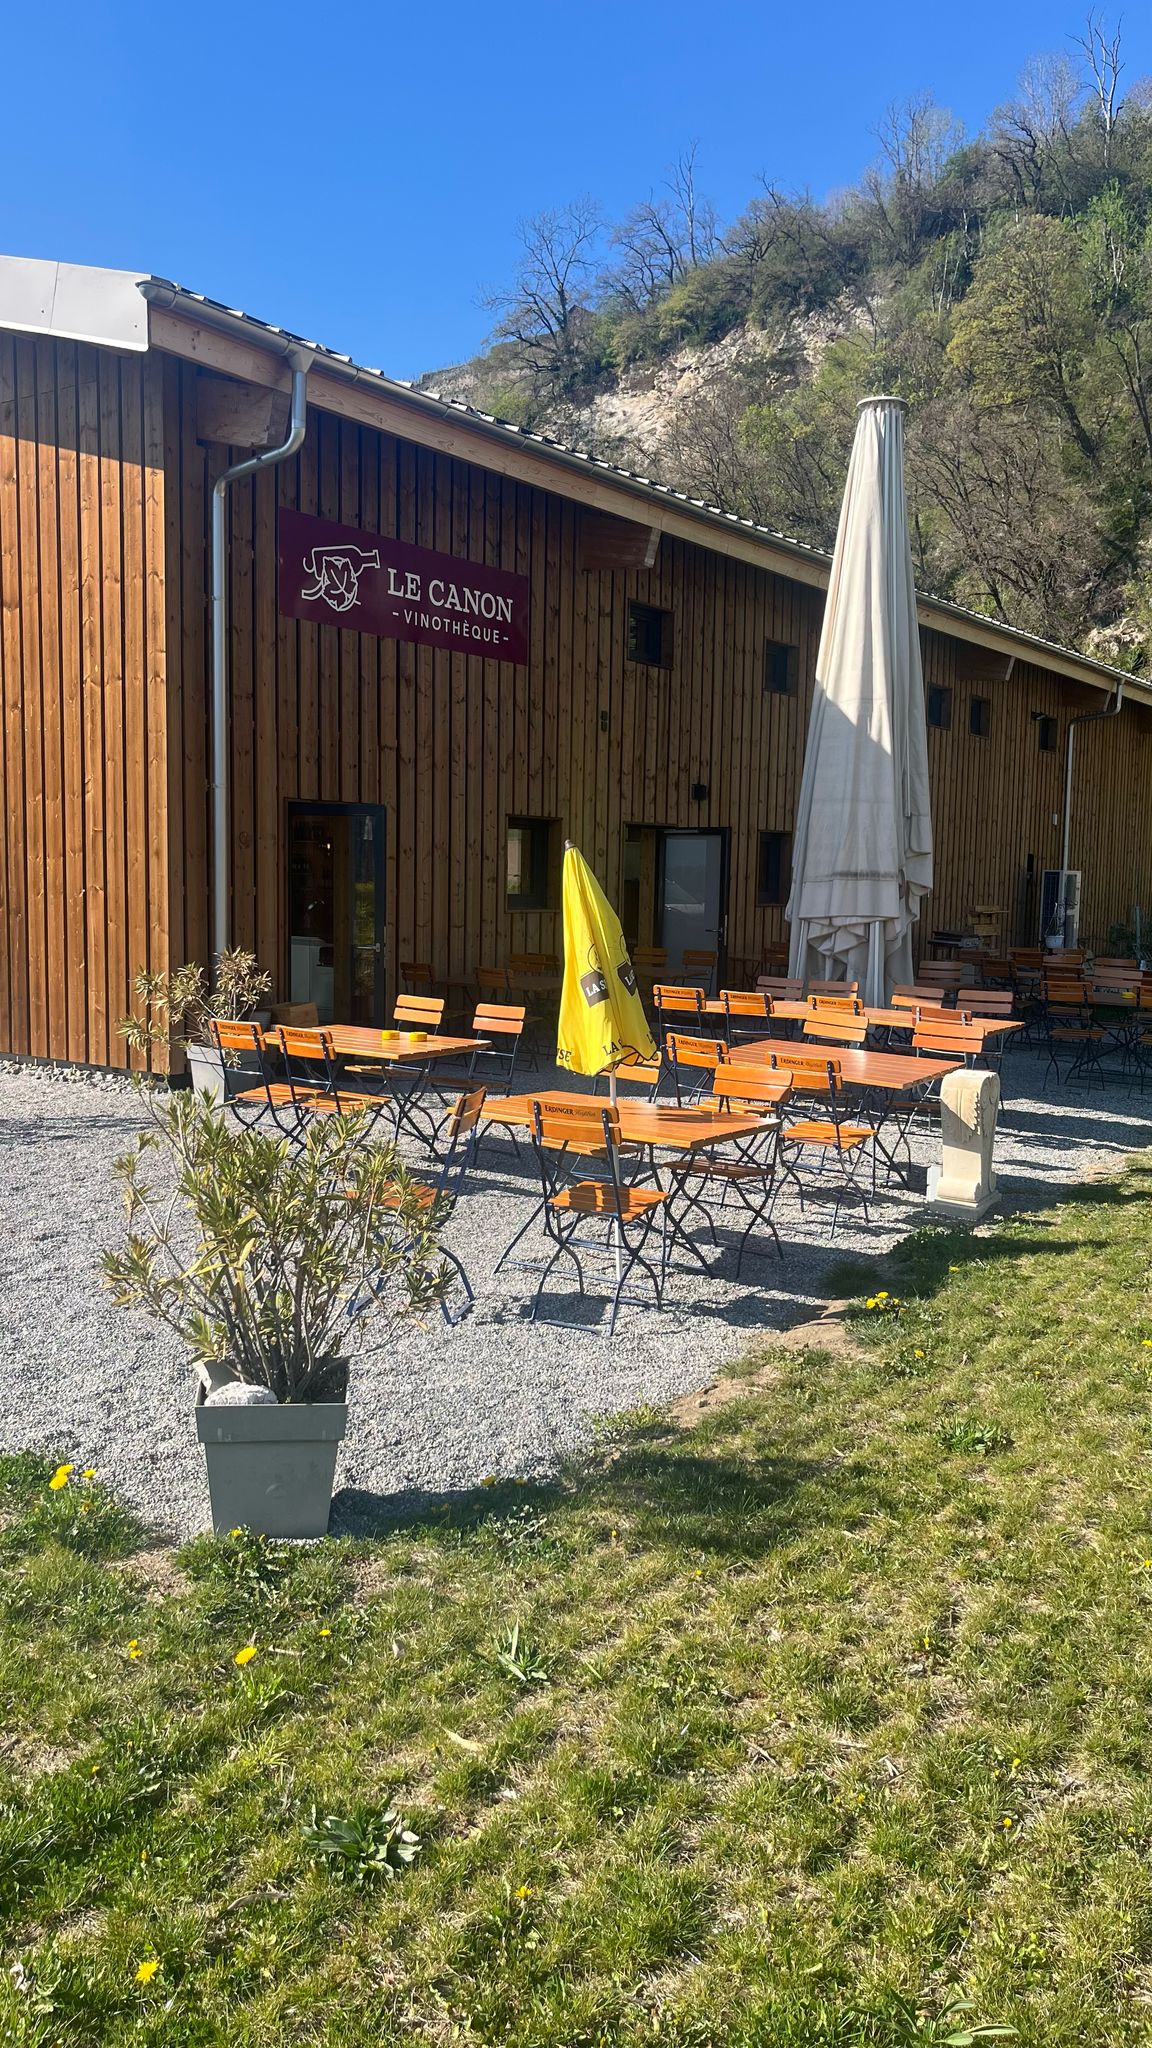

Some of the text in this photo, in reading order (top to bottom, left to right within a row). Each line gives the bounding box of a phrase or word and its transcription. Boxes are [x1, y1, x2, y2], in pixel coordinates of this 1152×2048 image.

[387, 567, 513, 623] LE CANON
[544, 1104, 574, 1116] ERDINGER
